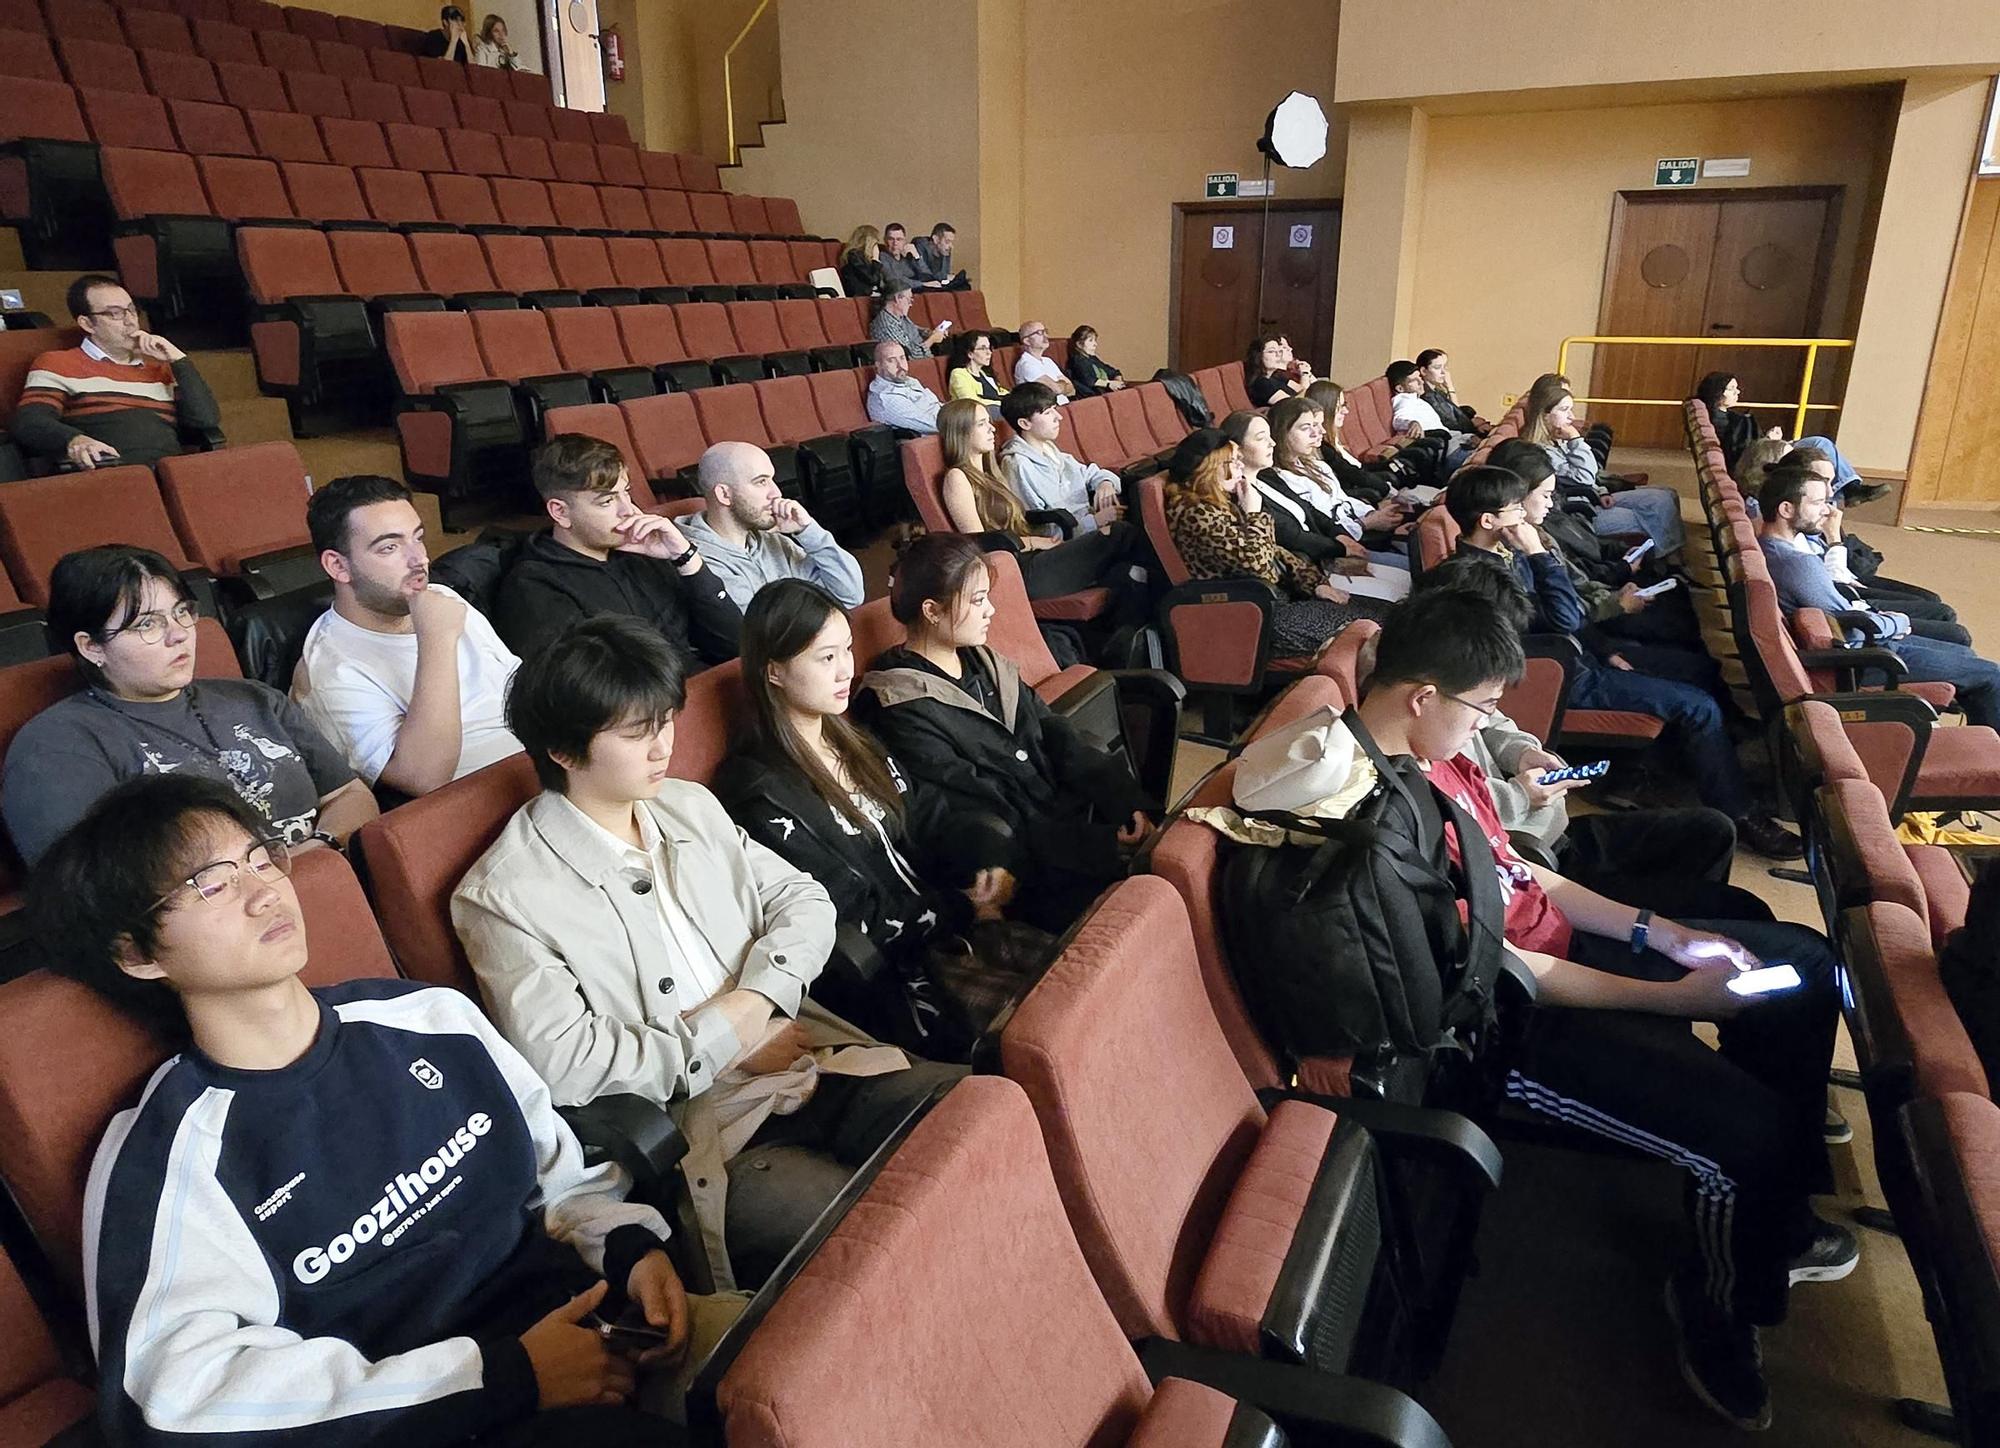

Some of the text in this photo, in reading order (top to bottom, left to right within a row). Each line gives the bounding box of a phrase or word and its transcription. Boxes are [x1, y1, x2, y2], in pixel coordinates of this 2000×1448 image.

[1659, 161, 1695, 169] SALIDA
[1208, 175, 1236, 184] SALIDA
[293, 1112, 492, 1284] Goozihouse
